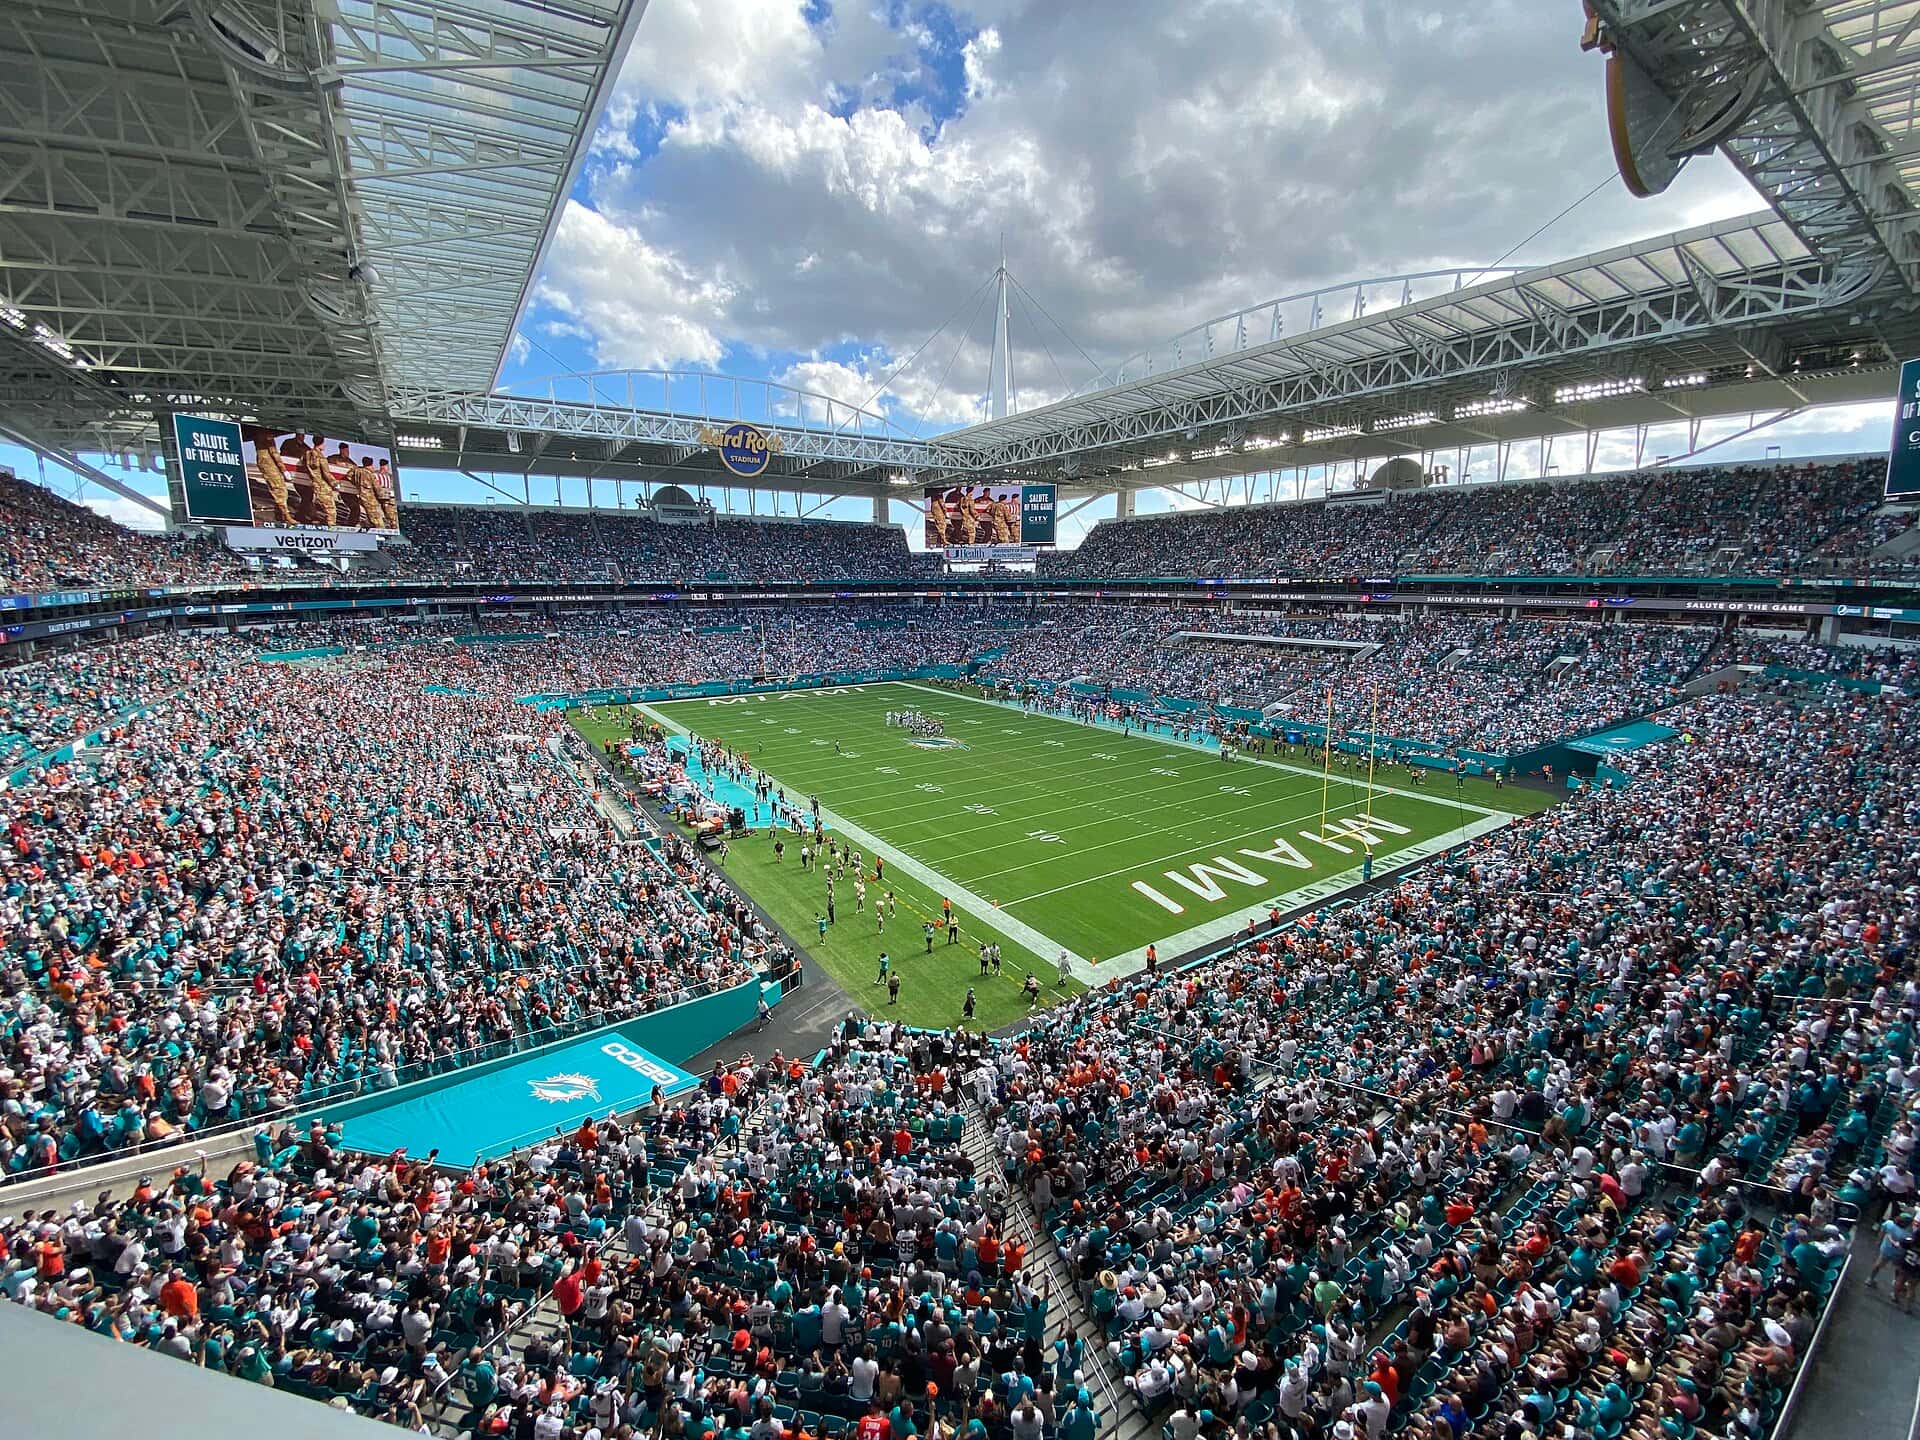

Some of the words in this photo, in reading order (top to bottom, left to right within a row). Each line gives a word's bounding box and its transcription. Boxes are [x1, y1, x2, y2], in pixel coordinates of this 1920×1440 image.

[192, 432, 230, 451] SALUTE
[700, 426, 743, 448] Hard
[745, 431, 785, 456] Rock
[185, 447, 197, 461] OF
[198, 449, 215, 463] THE
[216, 451, 241, 466] GAME
[730, 455, 760, 464] STADIUM
[198, 471, 233, 482] CITY
[1029, 493, 1049, 503] SALUTE
[275, 533, 334, 549] verizon
[1686, 601, 1725, 610] SALUTE
[1747, 603, 1768, 611] THE
[1772, 604, 1805, 612] GAME
[709, 687, 864, 706] MIAMI
[1025, 829, 1060, 842] 10
[1131, 813, 1412, 915] MIAMI
[1296, 888, 1325, 901] OF
[600, 1042, 680, 1085] GEICO
[793, 1151, 805, 1161] 25
[855, 1163, 865, 1171] 81
[1110, 1168, 1124, 1185] 32
[1055, 1178, 1066, 1188] 24
[613, 1188, 623, 1199] 13
[304, 1213, 315, 1225] 19
[900, 1240, 914, 1254] 95
[630, 1288, 642, 1300] 13
[590, 1299, 601, 1310] 17
